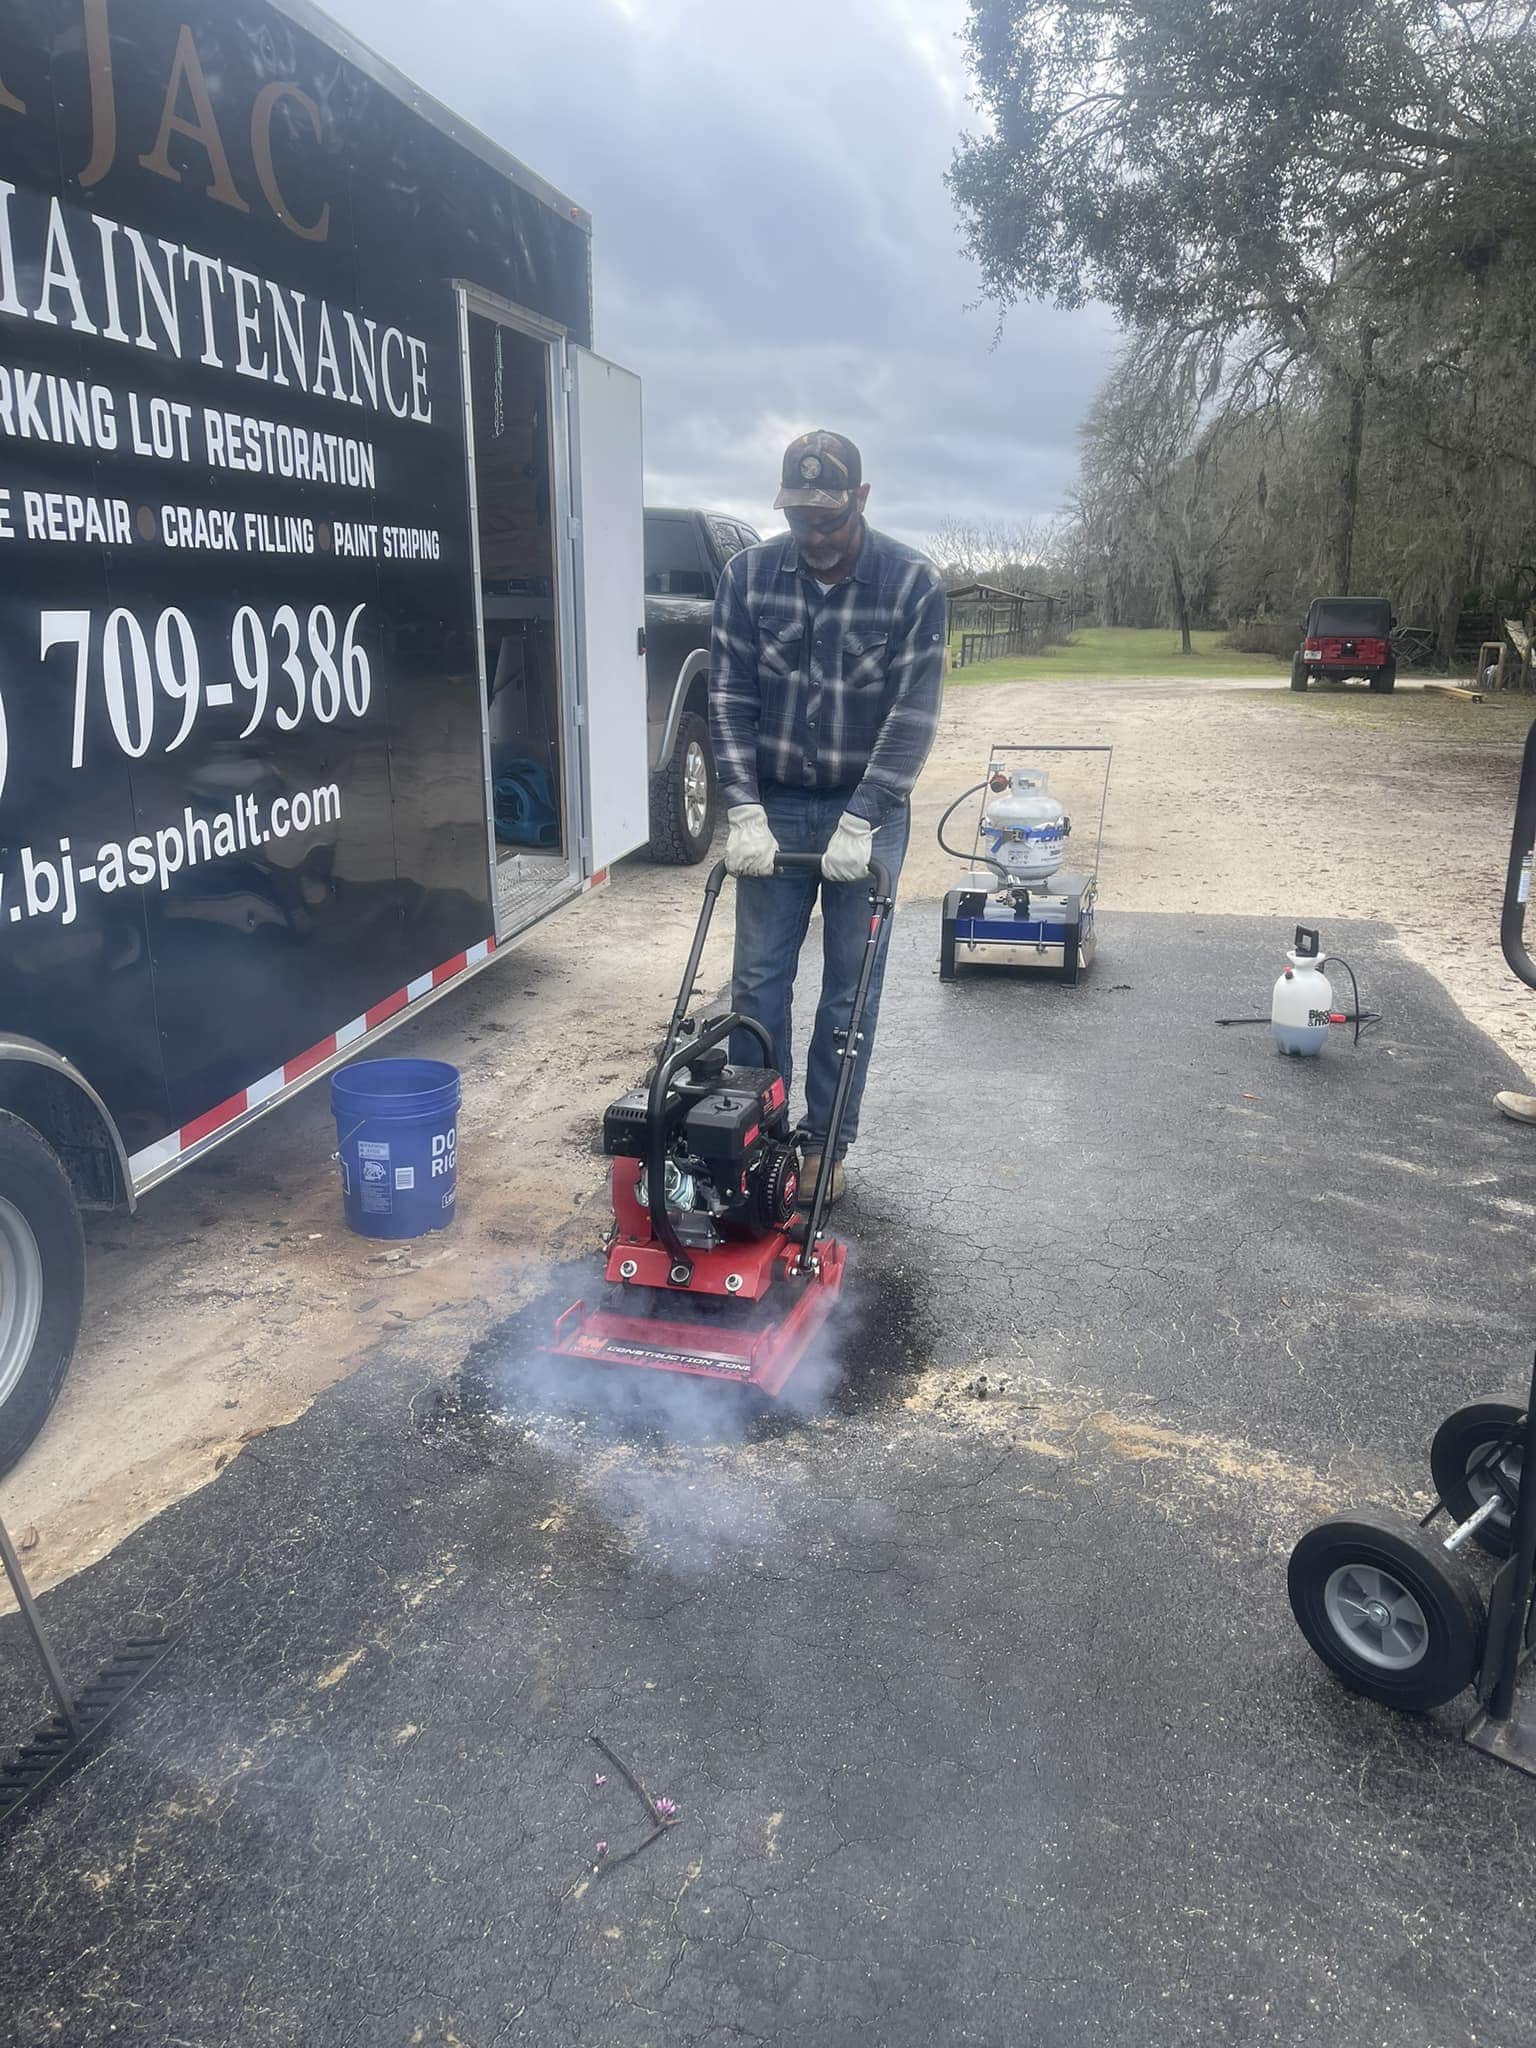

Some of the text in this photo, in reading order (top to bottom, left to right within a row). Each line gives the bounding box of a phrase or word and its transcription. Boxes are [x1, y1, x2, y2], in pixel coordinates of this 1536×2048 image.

[128, 391, 192, 463] LOT
[203, 408, 376, 489] RESTORATION
[23, 490, 132, 545] REPAIR
[161, 505, 239, 550] CRACK
[244, 512, 315, 554] FILLING
[333, 521, 378, 557] PAINT
[382, 526, 440, 560] STRIPING
[40, 602, 371, 769] 709-9386
[0, 783, 342, 925] .bj-asphalt.com
[432, 1128, 456, 1157] DO
[607, 1345, 713, 1366] CONSTRUCTION
[716, 1361, 751, 1372] ZONE
